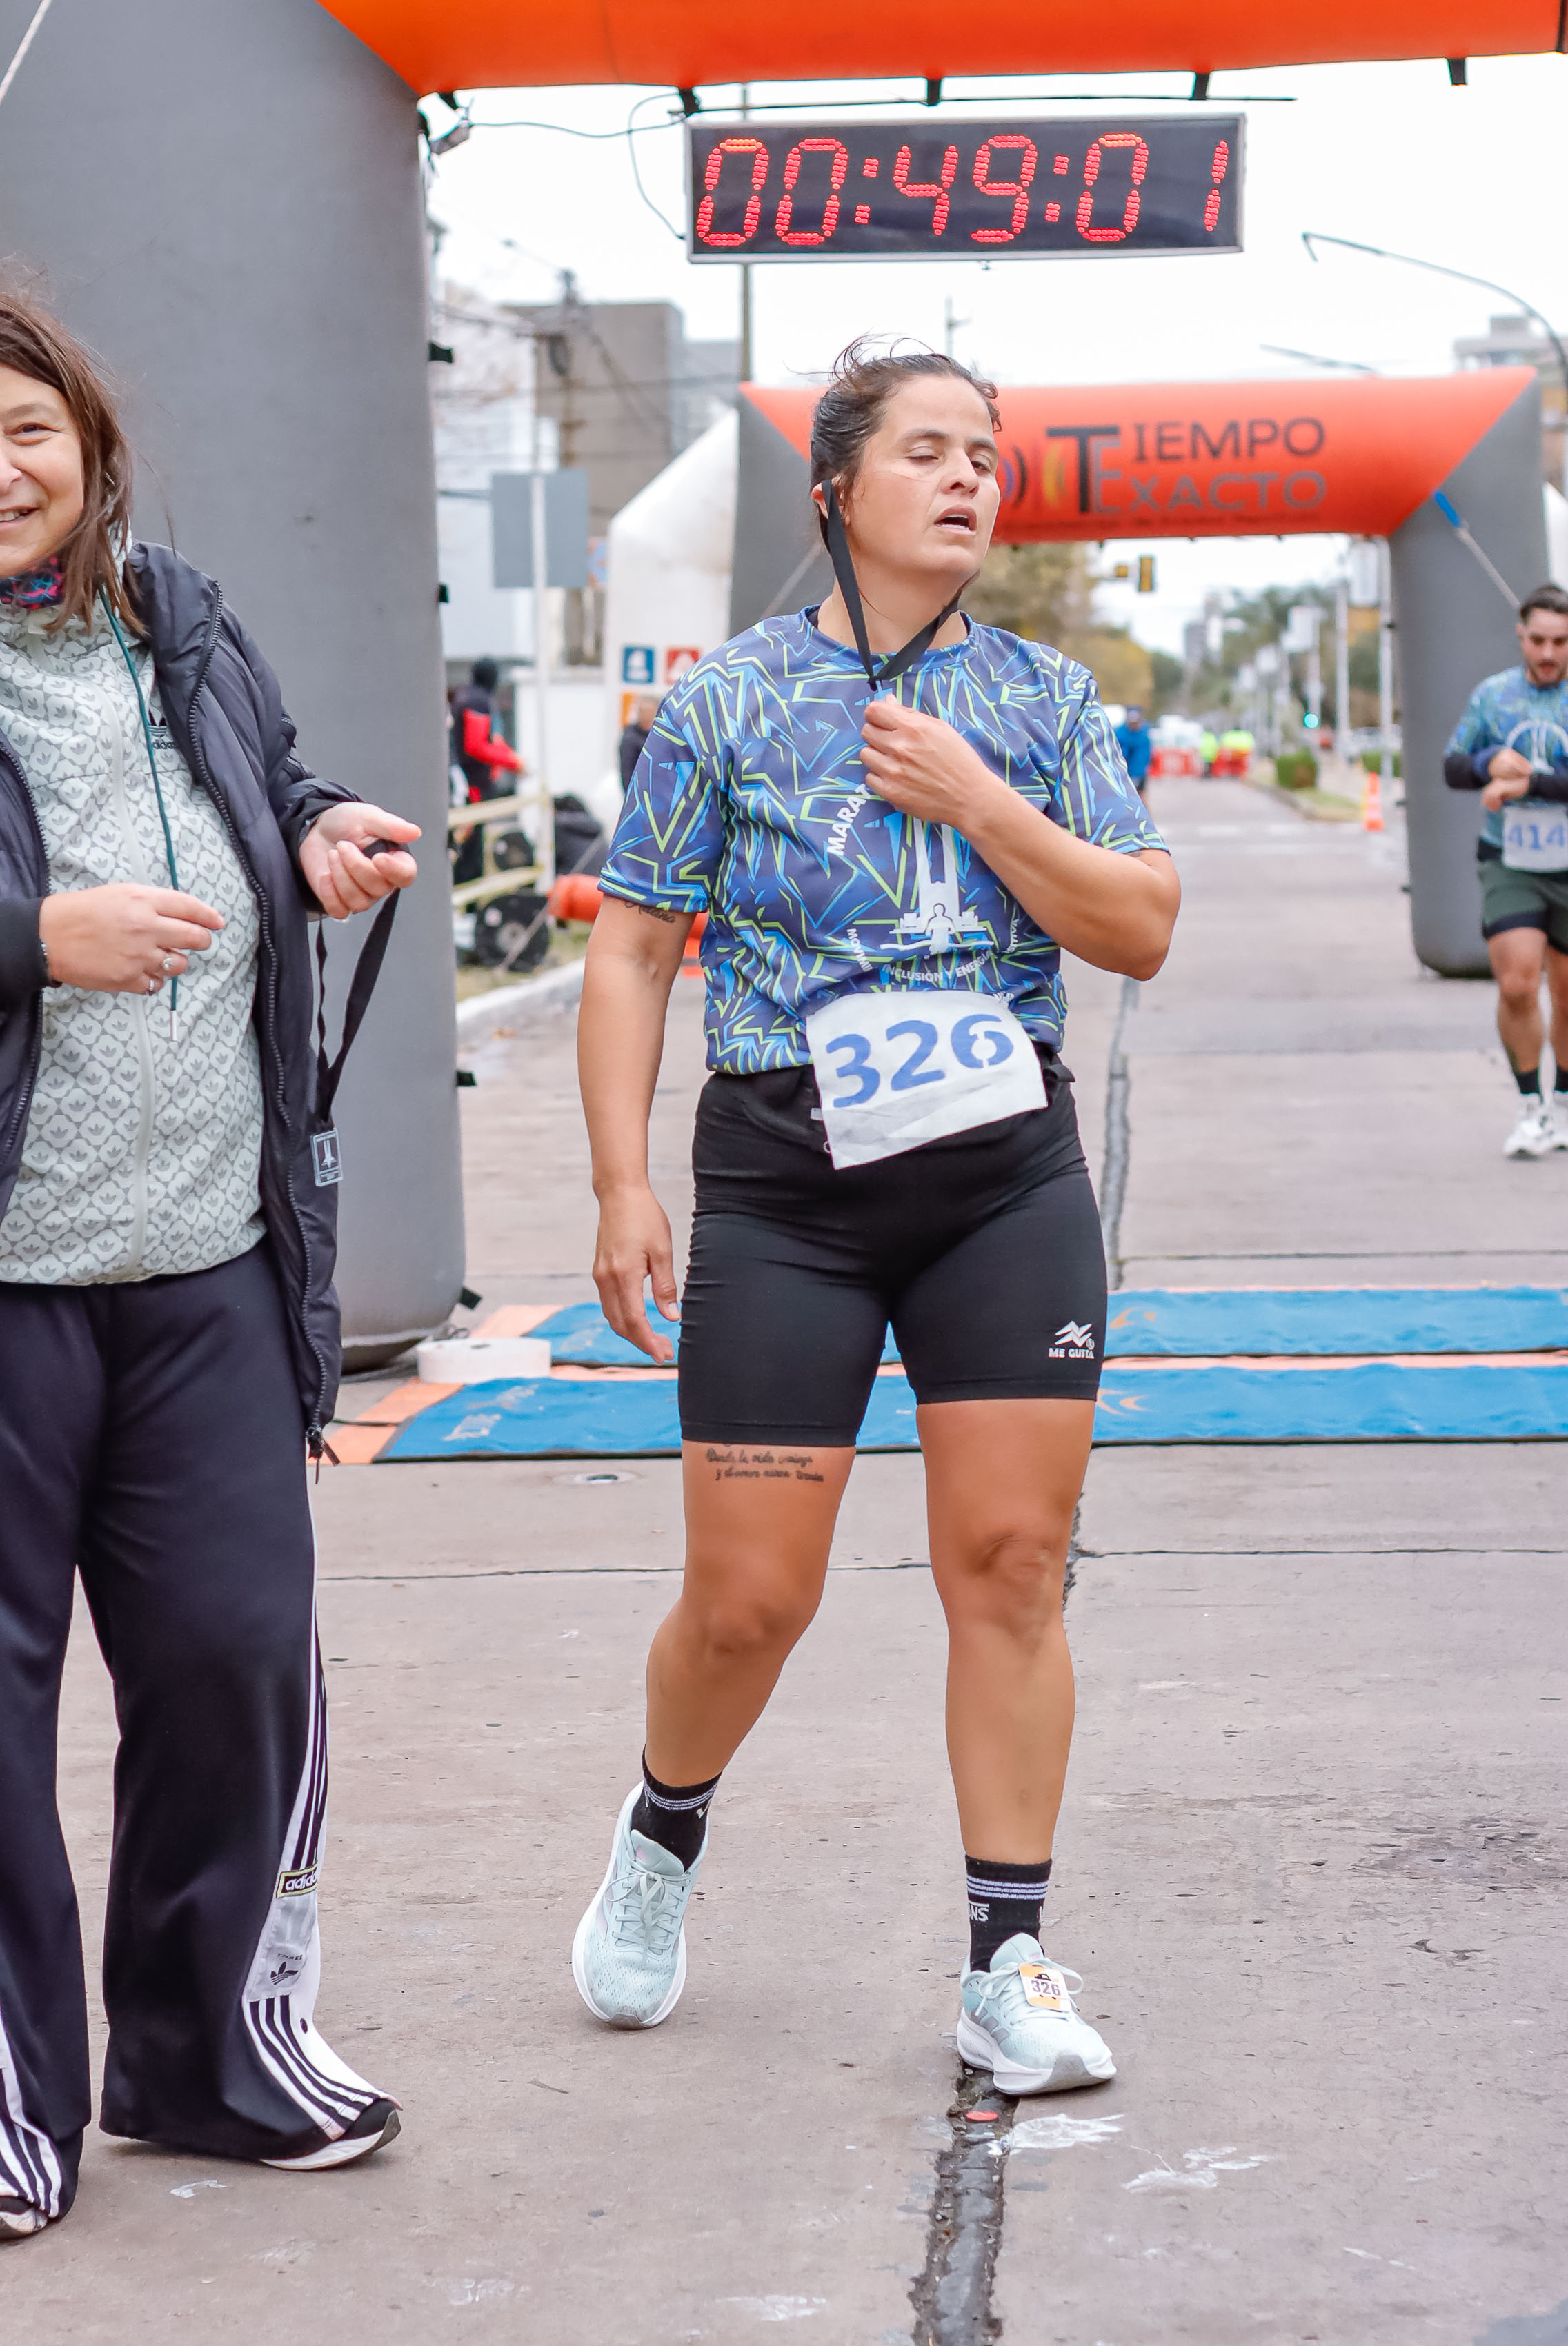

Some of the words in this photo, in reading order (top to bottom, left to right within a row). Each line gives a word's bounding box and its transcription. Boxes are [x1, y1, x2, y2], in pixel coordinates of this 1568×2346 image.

[1046, 417, 1326, 513] TIEMPO
[1091, 437, 1327, 515] EXACTO
[826, 783, 871, 856] MARAT
[1507, 824, 1565, 851] 414
[825, 1013, 1014, 1108] 326
[1048, 1347, 1066, 1358] ME
[285, 1871, 317, 1891] adida
[969, 1902, 989, 1922] NS
[1031, 1980, 1061, 1996] 326
